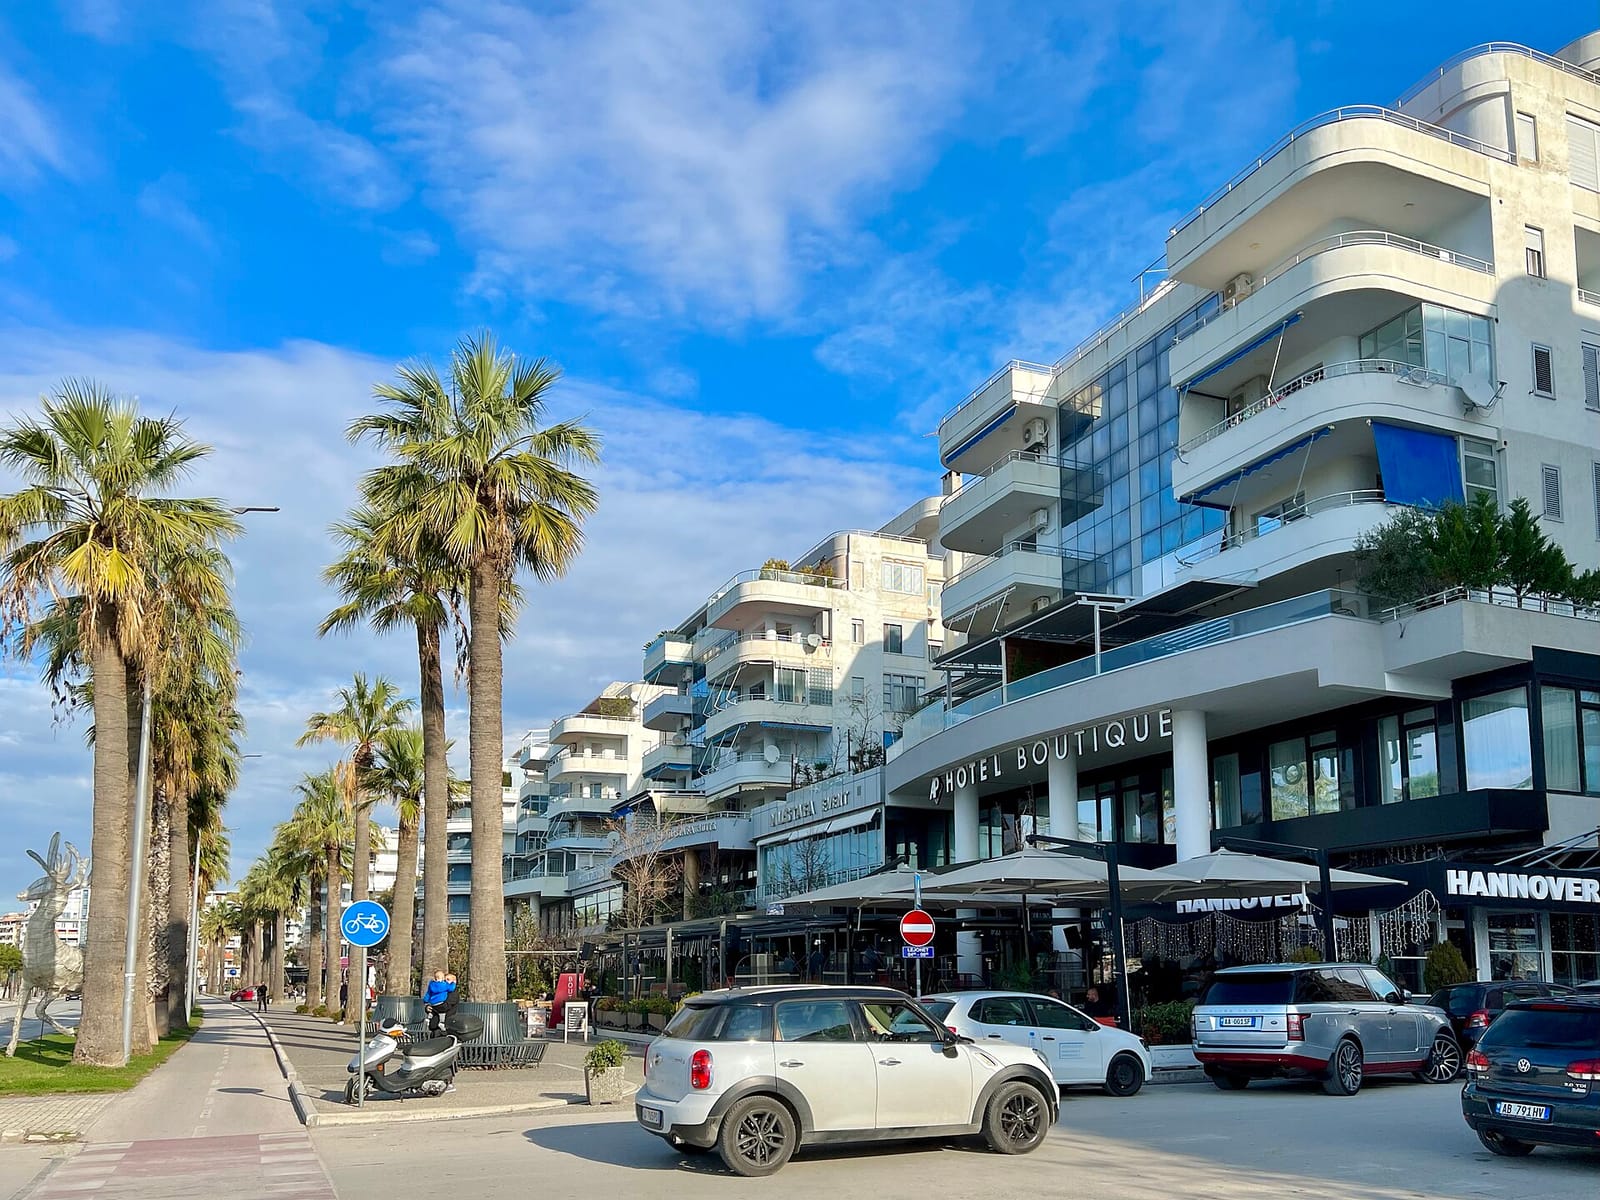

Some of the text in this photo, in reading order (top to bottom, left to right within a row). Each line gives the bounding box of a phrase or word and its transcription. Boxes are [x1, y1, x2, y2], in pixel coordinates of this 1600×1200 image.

[946, 754, 1001, 793] HOTEL
[1017, 708, 1173, 770] BOUTIQUE
[1447, 869, 1600, 902] HANNOVER
[1502, 1103, 1512, 1114] AB
